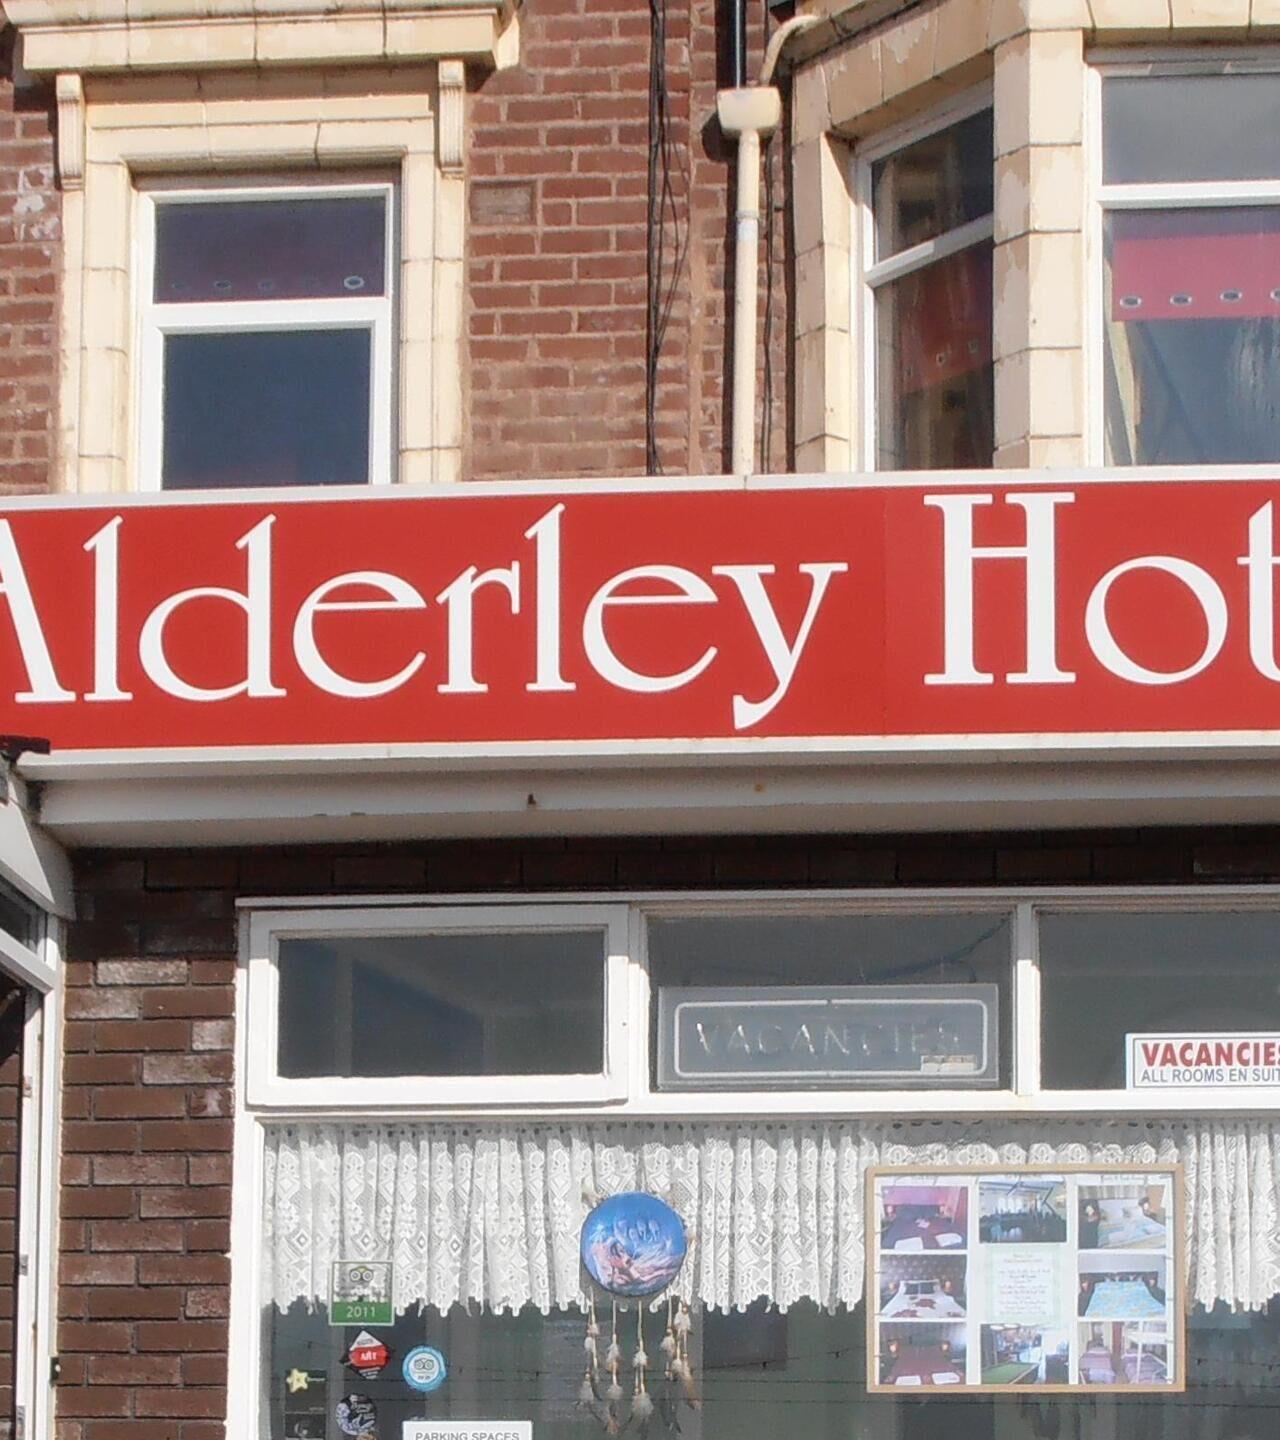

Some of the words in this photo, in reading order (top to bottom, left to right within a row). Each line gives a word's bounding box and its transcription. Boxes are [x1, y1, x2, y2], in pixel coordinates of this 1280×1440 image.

[1141, 1068, 1168, 1083] ALL
[1172, 1068, 1225, 1083] ROOMS
[1229, 1068, 1248, 1082] EN
[346, 1305, 377, 1319] 2011
